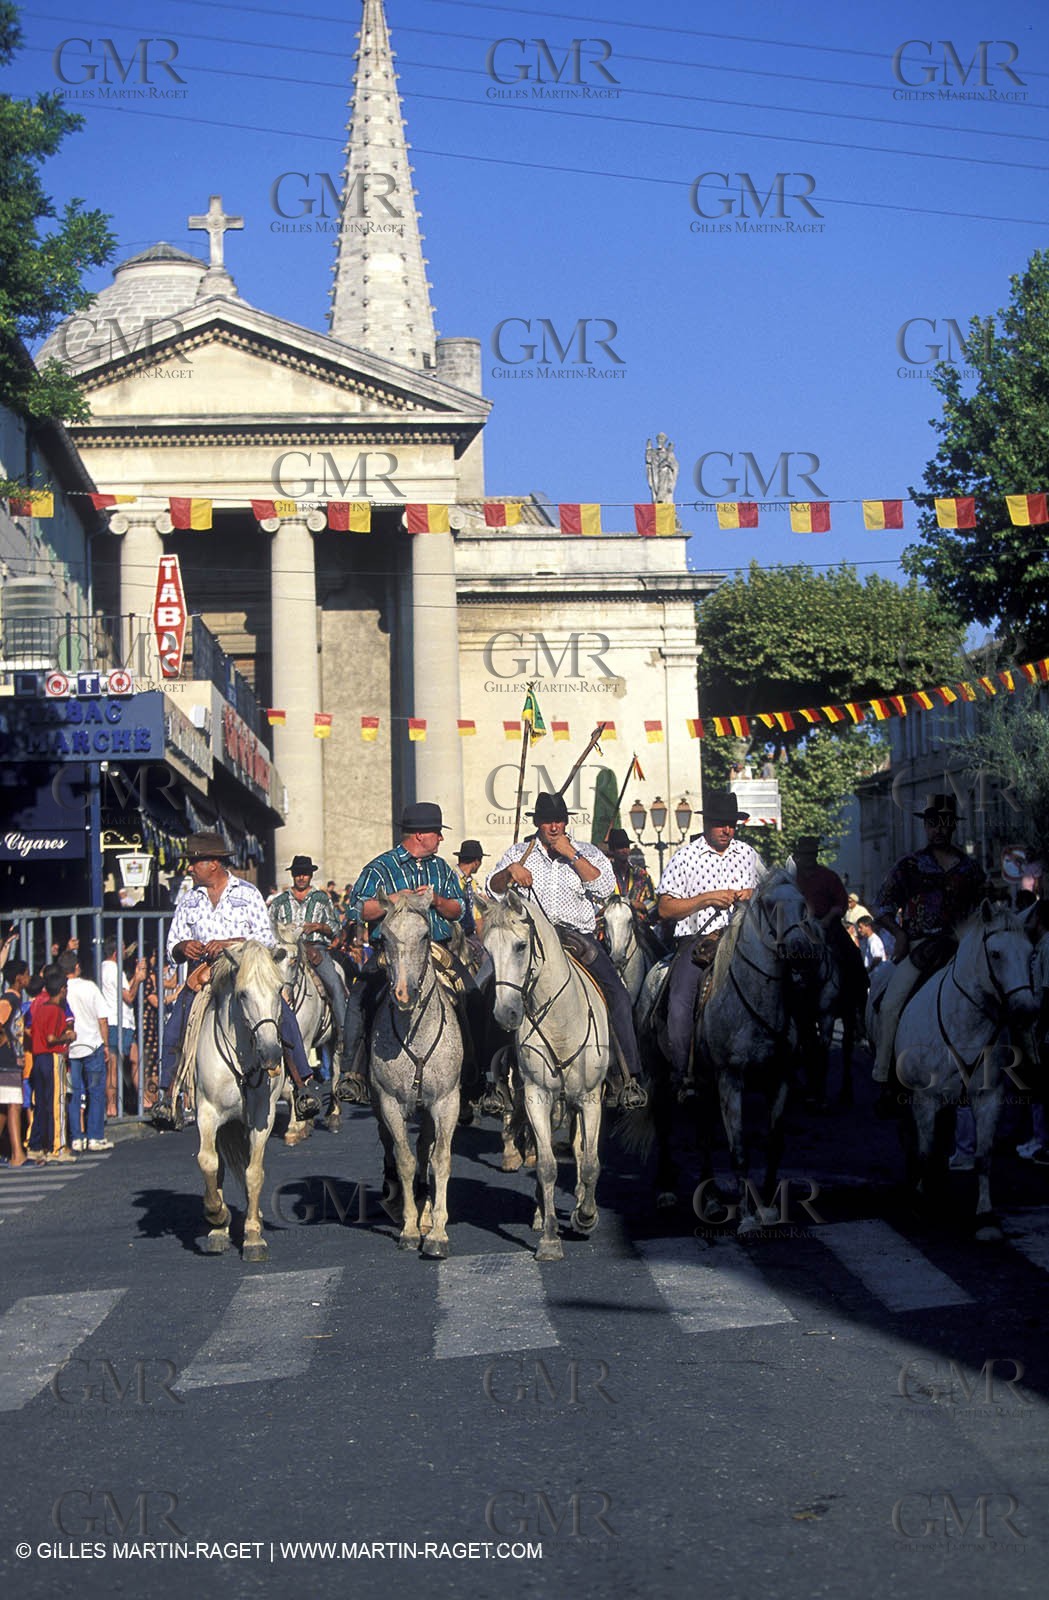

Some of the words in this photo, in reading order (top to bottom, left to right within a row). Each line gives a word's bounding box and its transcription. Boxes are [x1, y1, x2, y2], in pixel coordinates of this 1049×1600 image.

[157, 560, 181, 673] TABAC
[16, 671, 131, 696] LOTO
[4, 832, 69, 857] Cigares
